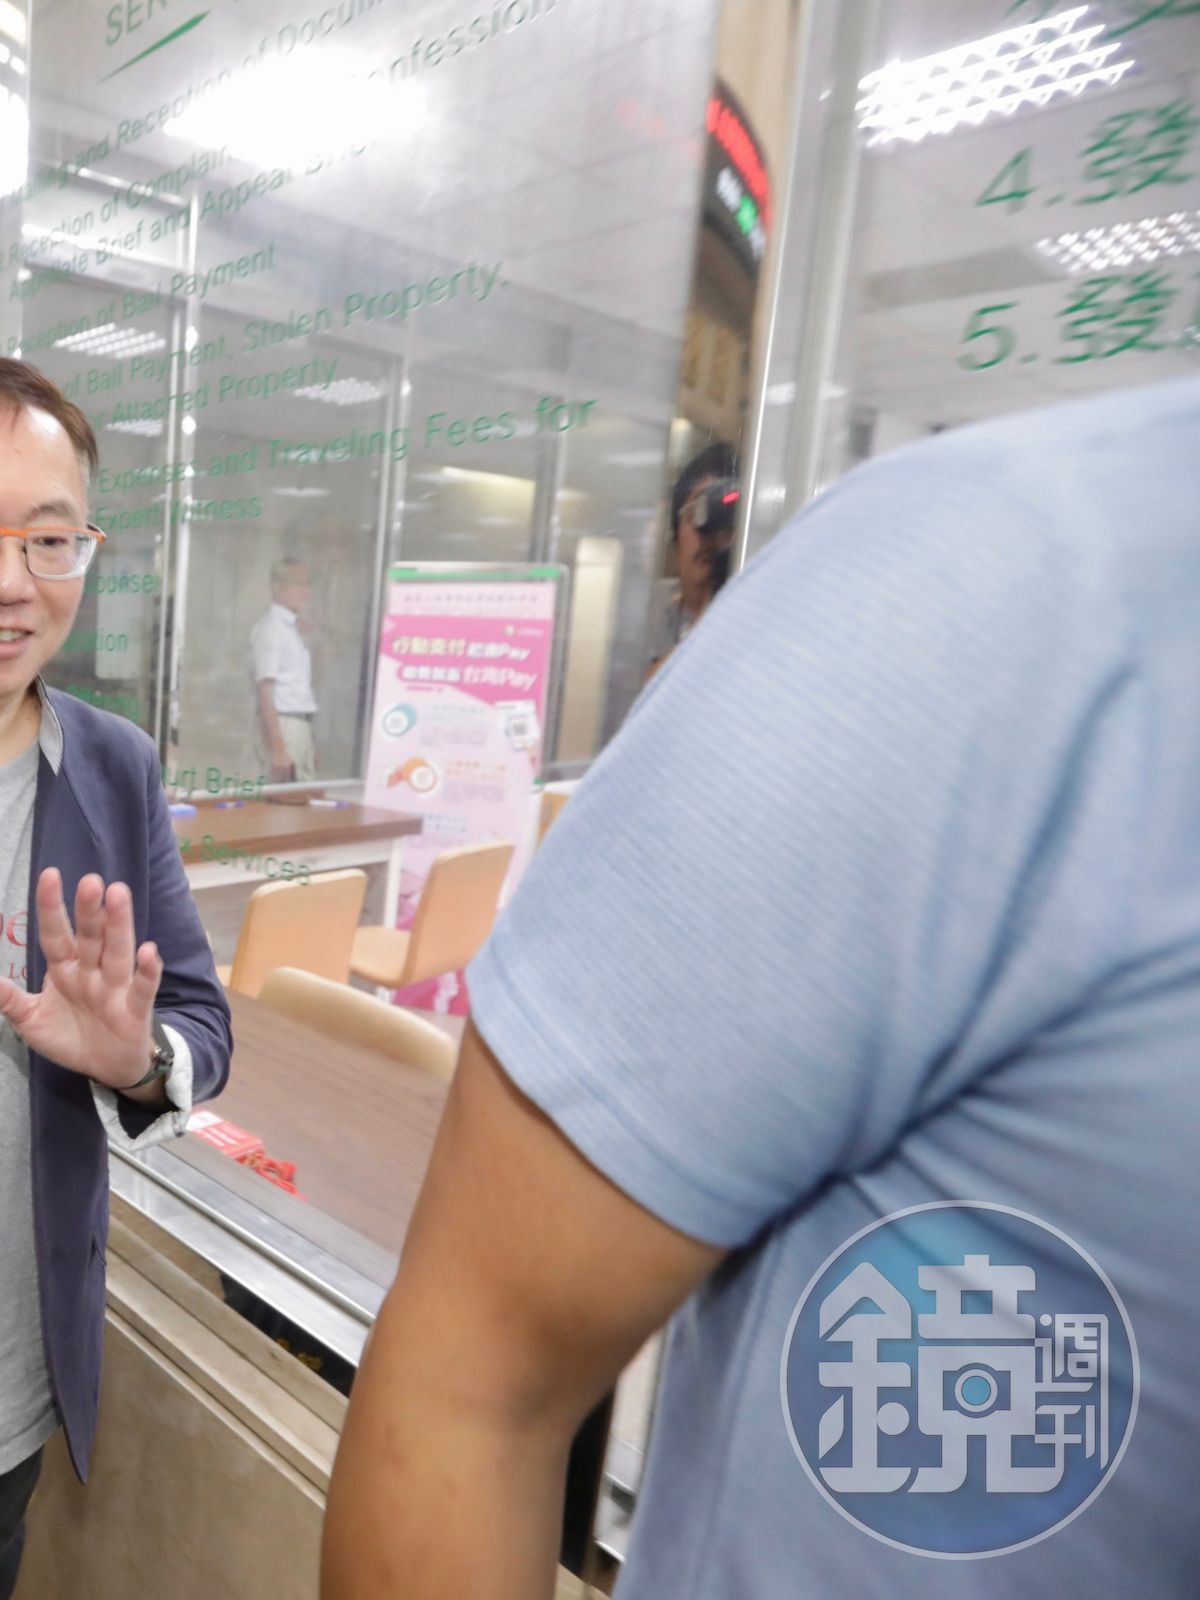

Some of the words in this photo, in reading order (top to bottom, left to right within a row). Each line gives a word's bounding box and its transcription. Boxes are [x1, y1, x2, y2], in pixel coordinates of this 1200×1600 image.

[170, 244, 276, 301] Payment
[242, 305, 332, 353] Stolen
[219, 357, 341, 400] Property
[209, 445, 257, 479] and
[270, 424, 411, 469] Traveling
[424, 411, 516, 449] Fees
[535, 393, 599, 433] for
[202, 834, 310, 886] Services
